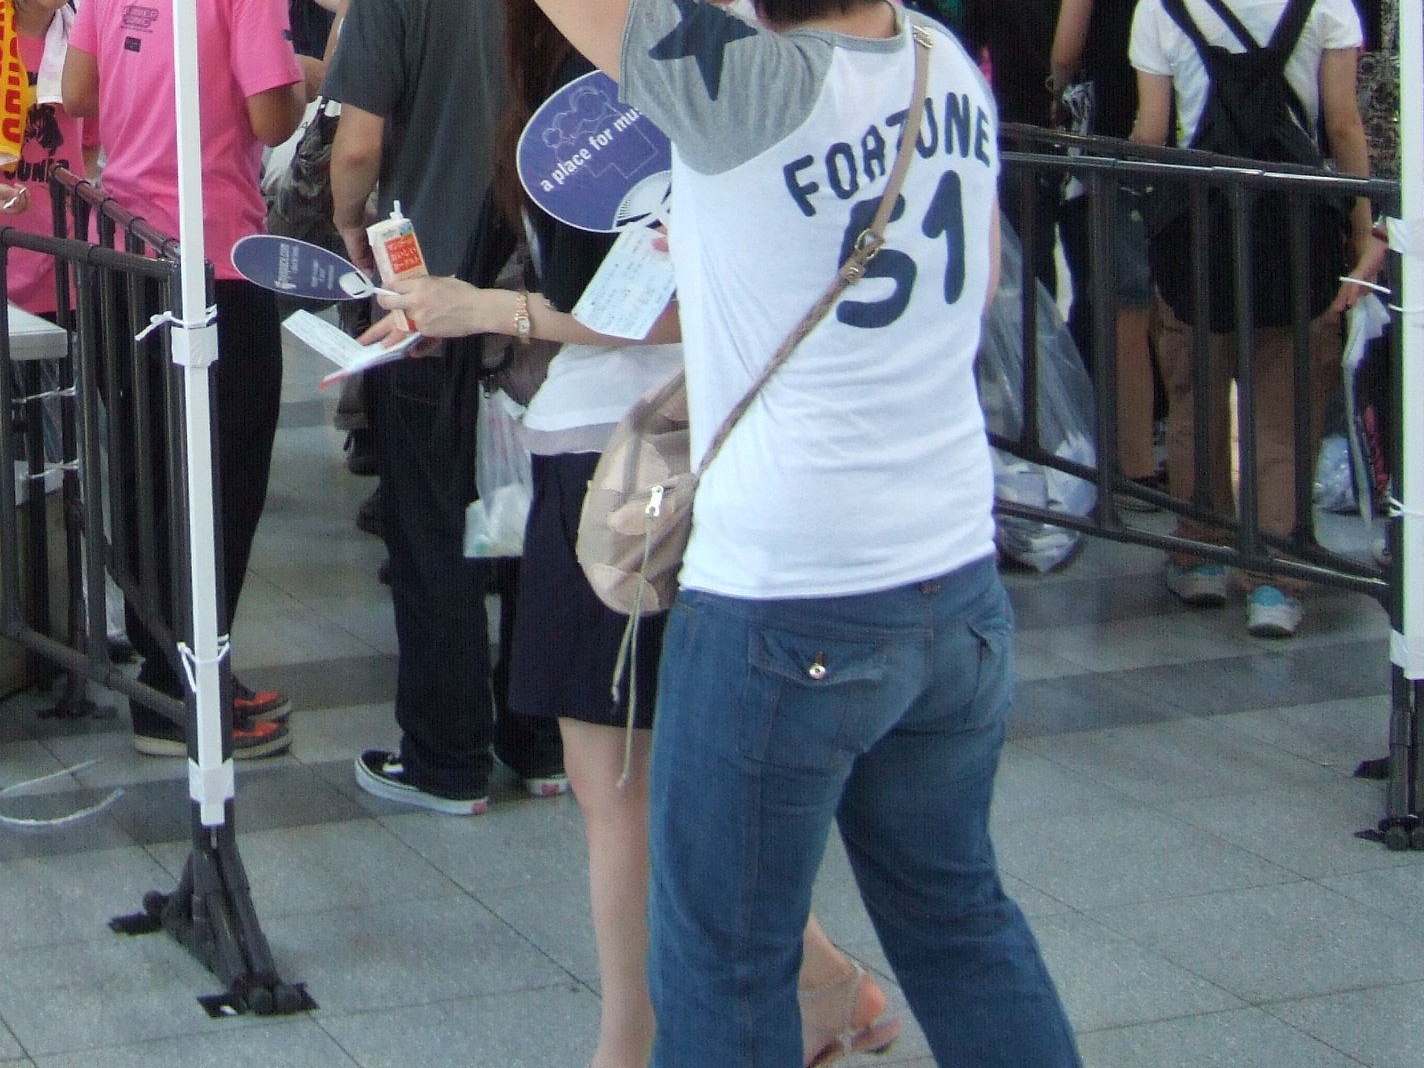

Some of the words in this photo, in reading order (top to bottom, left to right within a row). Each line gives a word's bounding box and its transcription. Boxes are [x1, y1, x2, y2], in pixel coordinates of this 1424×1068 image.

[541, 179, 554, 192] a
[551, 148, 592, 185] place
[589, 129, 614, 151] for
[783, 92, 990, 217] FORTUNE
[836, 170, 966, 329] 51
